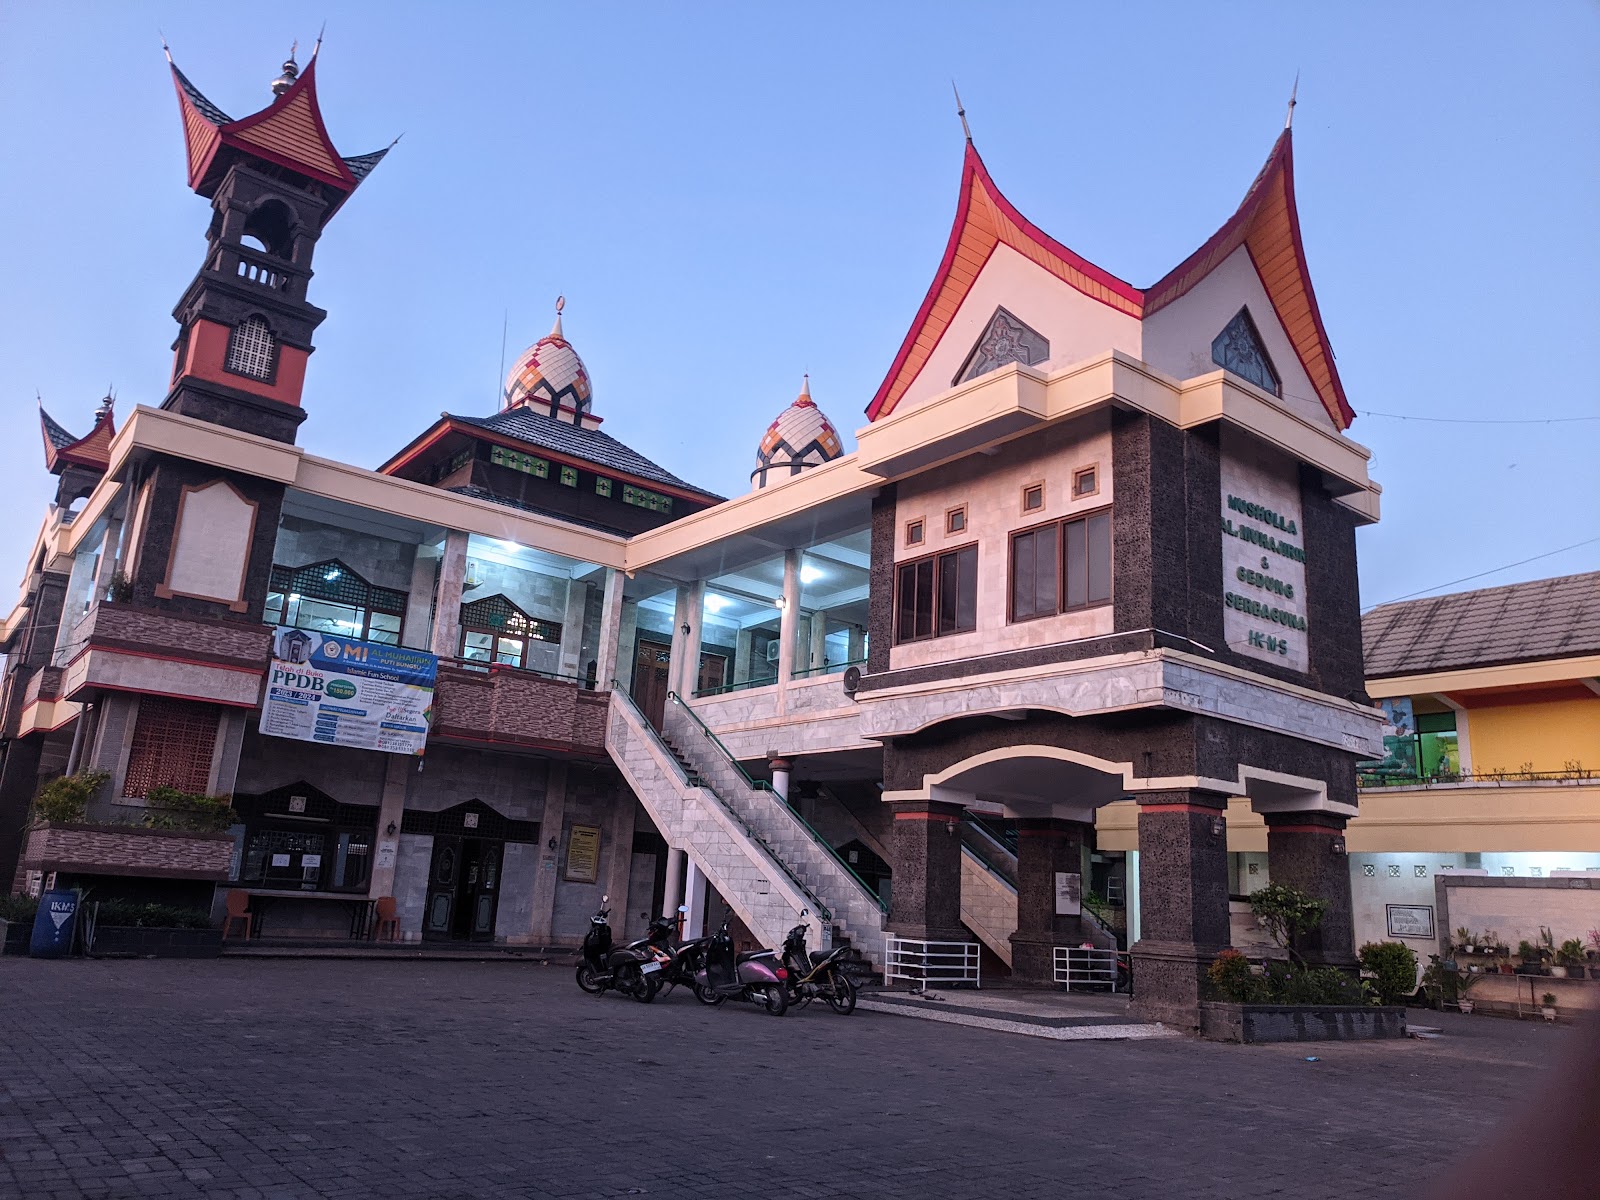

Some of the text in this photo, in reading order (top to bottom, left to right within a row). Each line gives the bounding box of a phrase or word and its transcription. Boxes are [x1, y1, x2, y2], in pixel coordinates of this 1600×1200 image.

[1227, 494, 1298, 535] MUSHOLLA
[1260, 556, 1270, 570] &
[1236, 565, 1294, 599] GEDUNG
[1225, 591, 1307, 632] SERBAGUNA
[343, 643, 369, 662] MI
[371, 648, 431, 665] AL MUHAJIRIN
[276, 663, 295, 673] Telah
[306, 669, 324, 678] Buka
[380, 658, 422, 671] PUTI BUNGSU
[272, 669, 325, 691] PPDB
[346, 667, 400, 681] Islamic Fun School
[298, 692, 316, 701] 2024
[385, 712, 417, 722] Daftarkan
[403, 707, 421, 715] Segera
